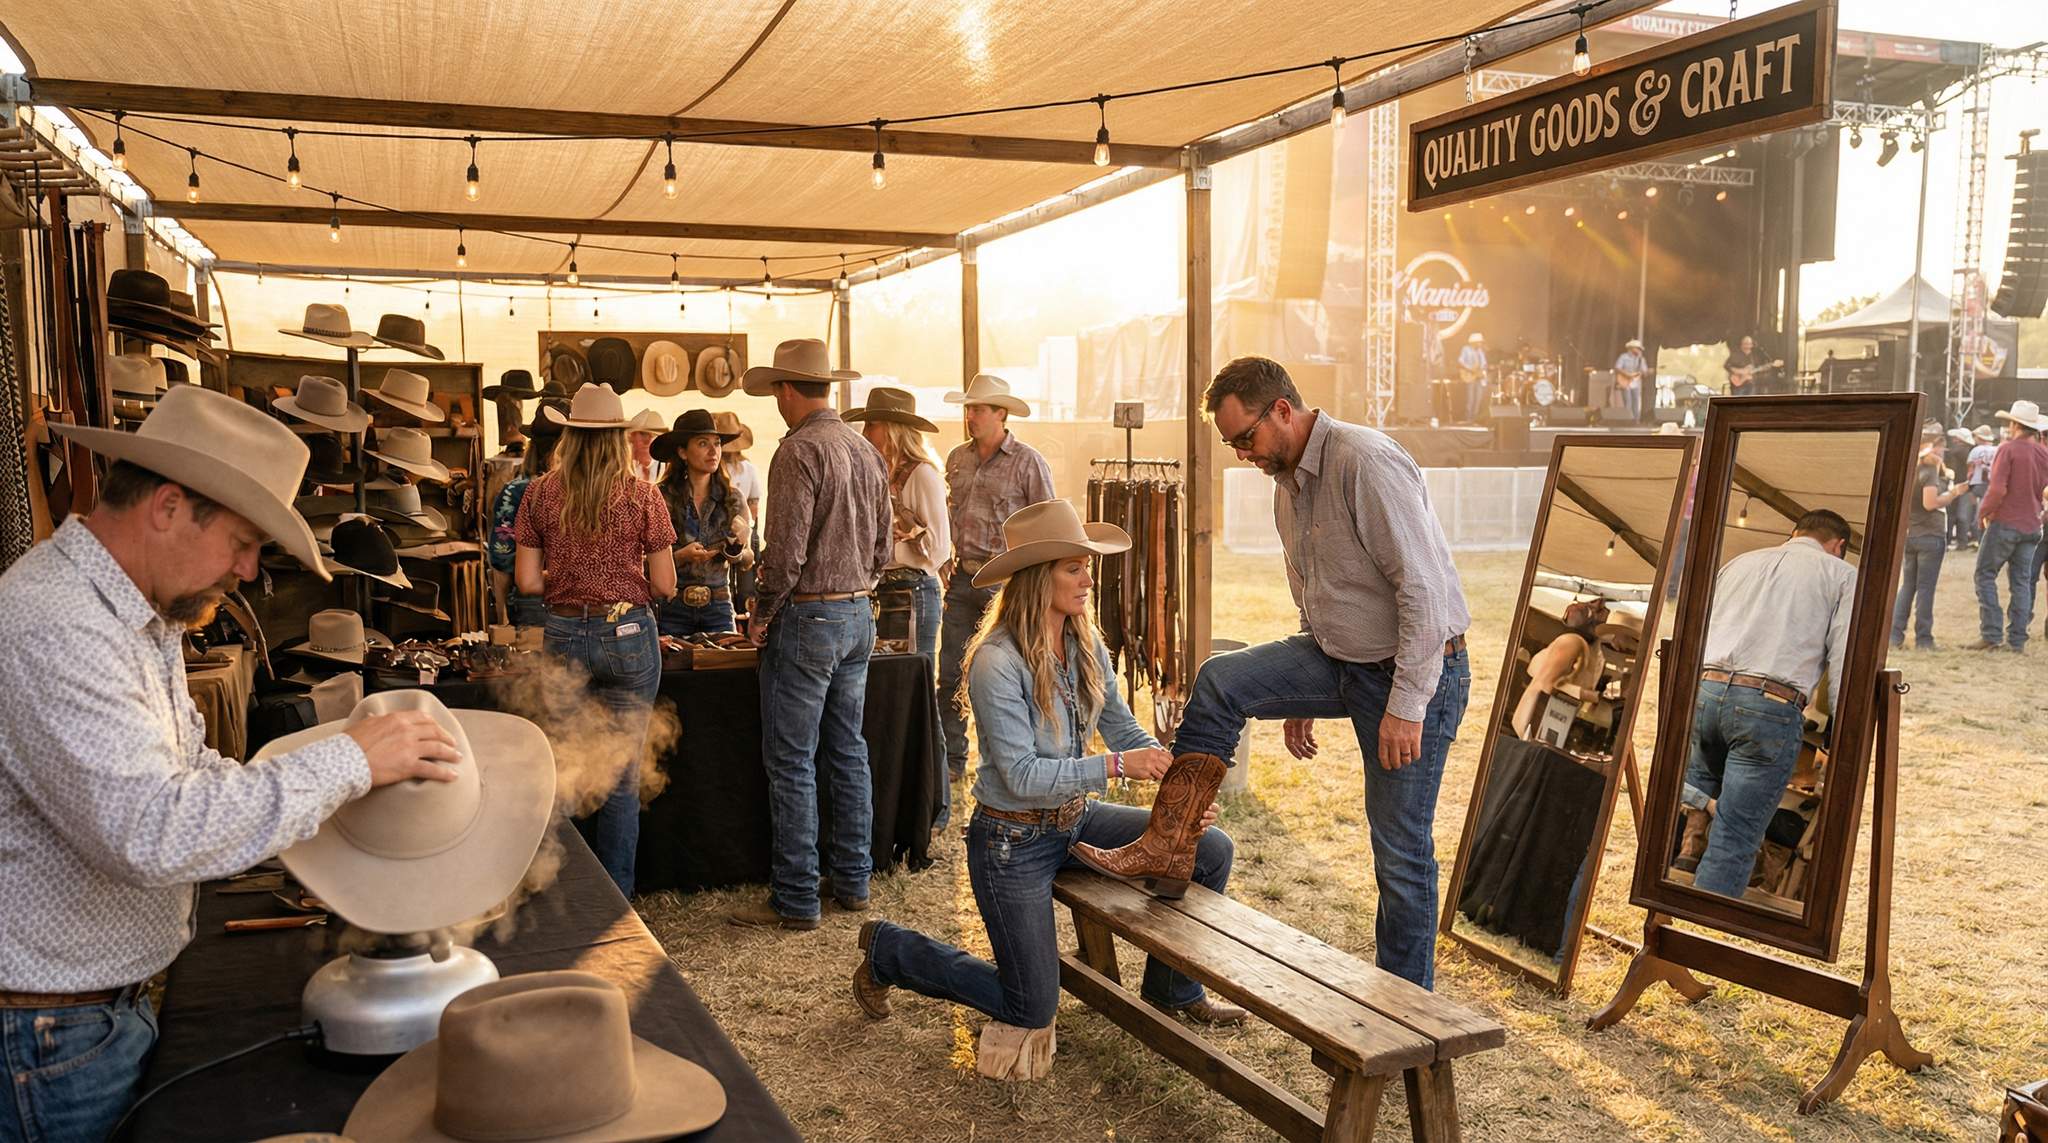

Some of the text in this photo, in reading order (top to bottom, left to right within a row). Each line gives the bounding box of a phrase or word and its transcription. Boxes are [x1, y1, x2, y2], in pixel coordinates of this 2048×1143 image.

[1632, 14, 1687, 36] QUALITY
[1423, 33, 1801, 191] QUALITY GOODS & CRAFT
